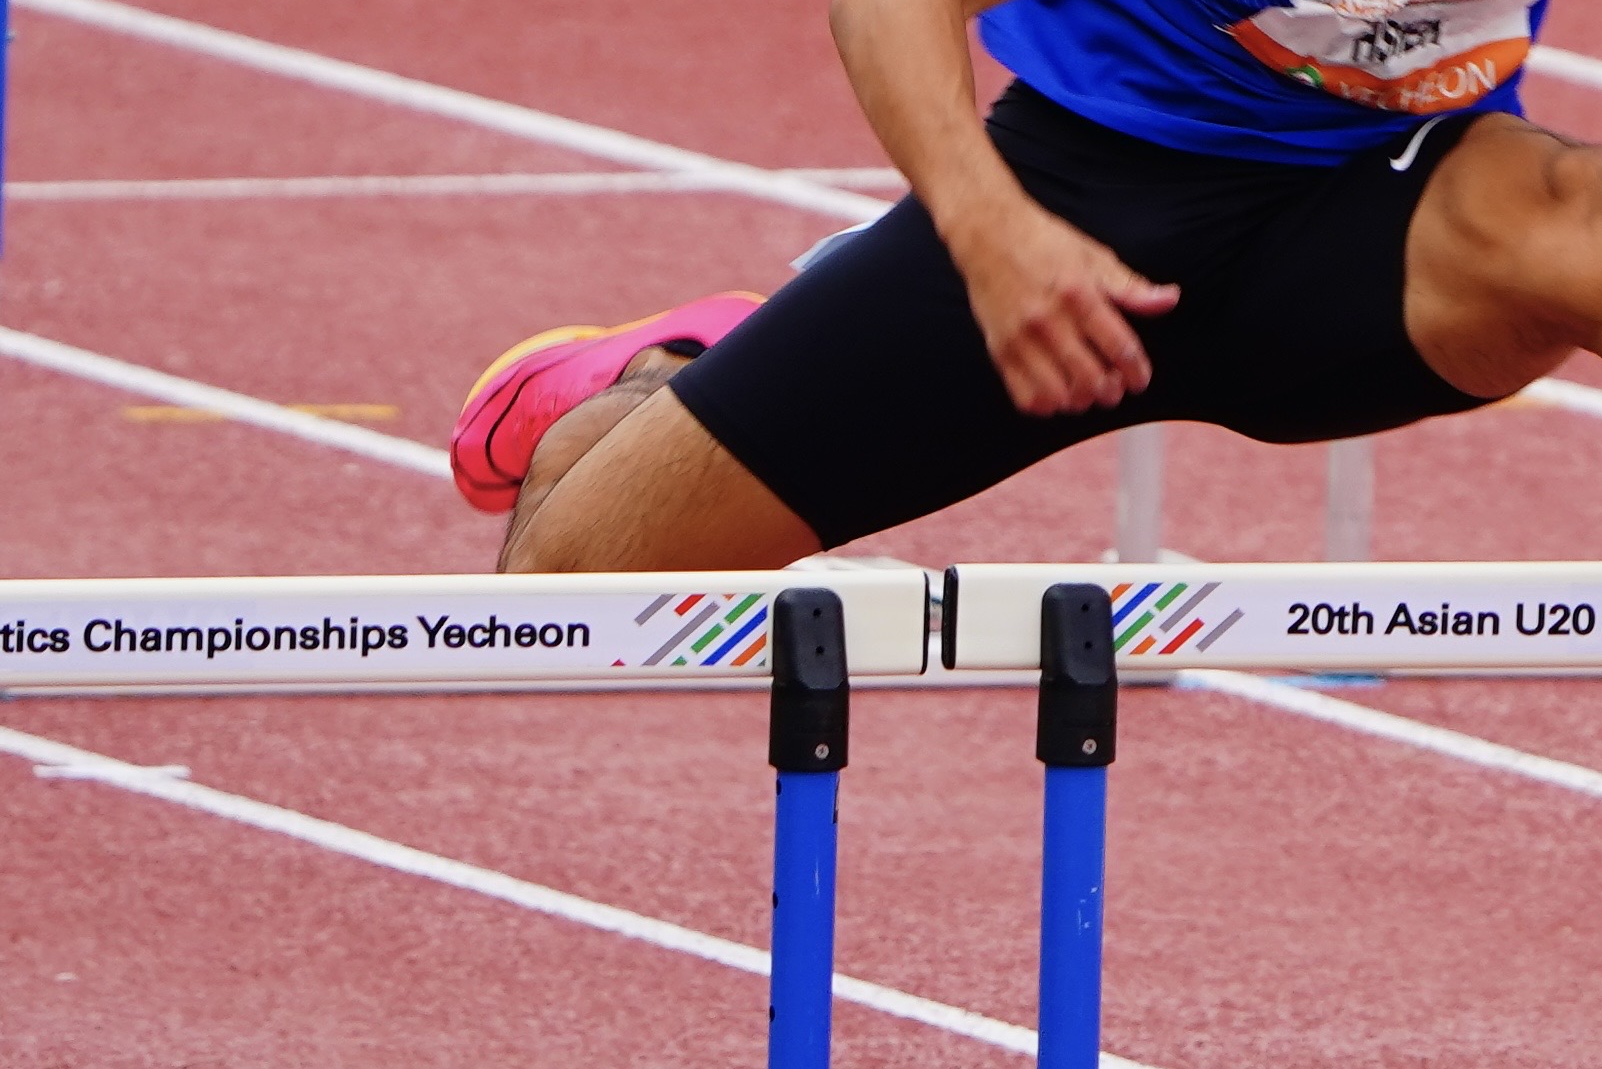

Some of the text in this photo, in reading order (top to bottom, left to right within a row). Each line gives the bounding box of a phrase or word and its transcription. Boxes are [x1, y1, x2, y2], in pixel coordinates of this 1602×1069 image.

[83, 616, 409, 659] Championships
[416, 615, 590, 649] Yecheon
[1286, 602, 1374, 635] 20th
[1384, 602, 1500, 636] Asian
[1516, 603, 1596, 636] U20
